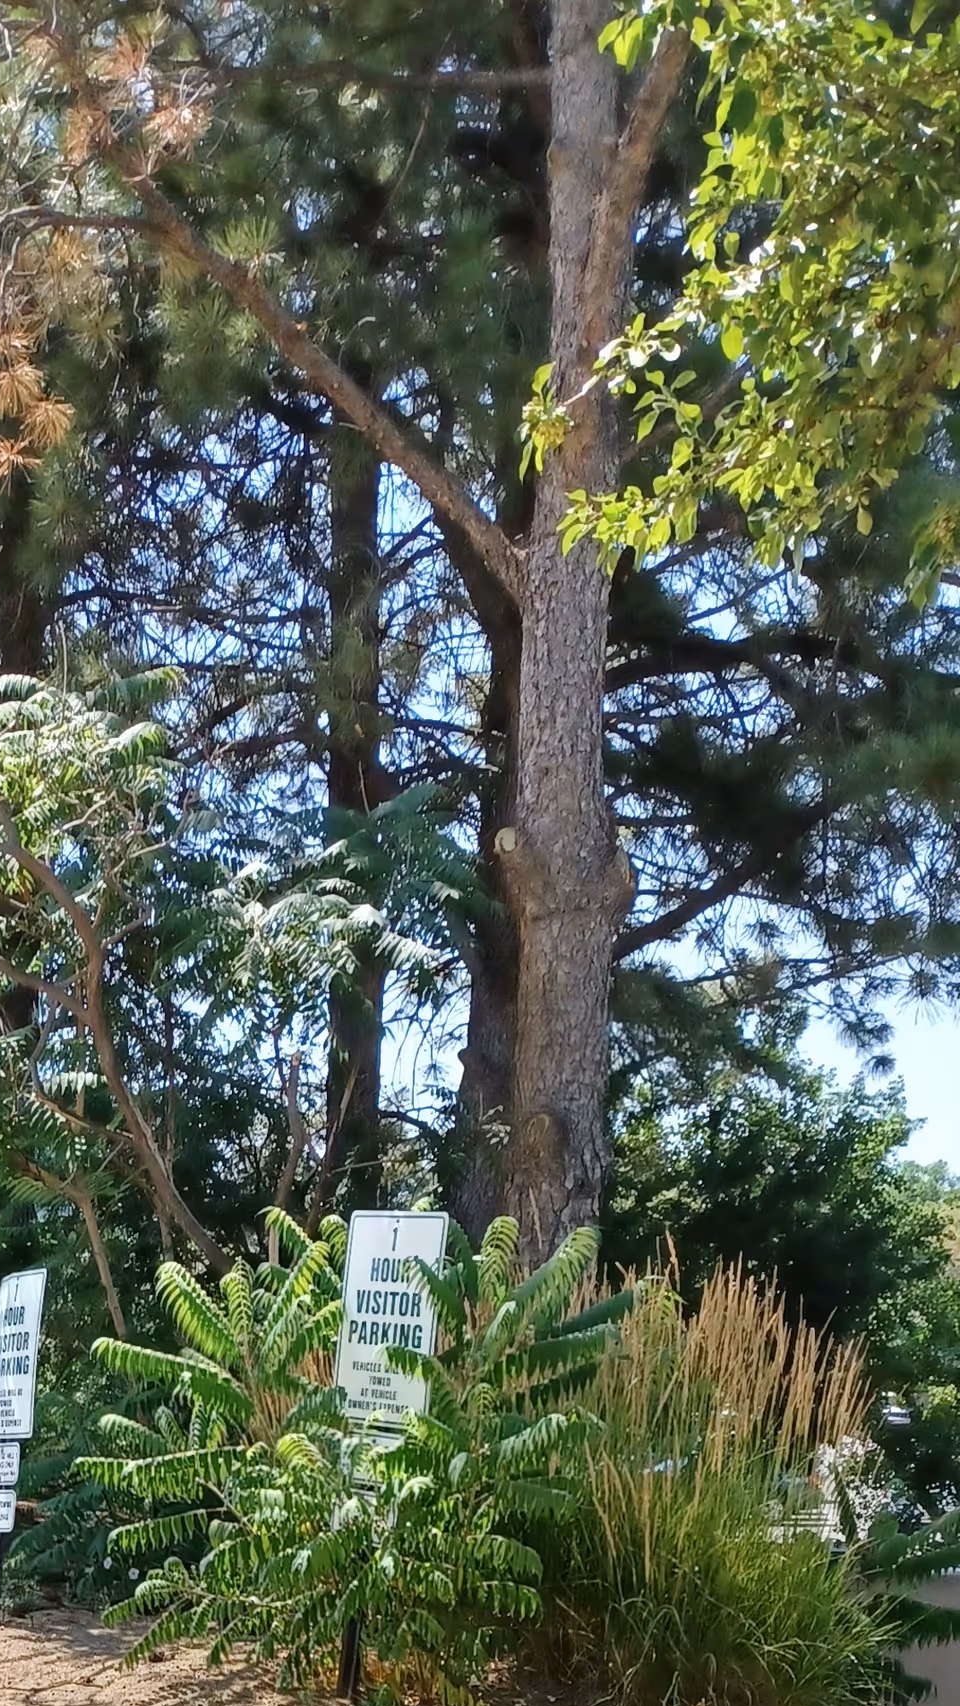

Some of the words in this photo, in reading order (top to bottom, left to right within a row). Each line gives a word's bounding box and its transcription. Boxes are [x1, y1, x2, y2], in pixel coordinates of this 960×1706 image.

[392, 1227, 398, 1251] 1
[357, 1290, 422, 1317] VISITOR
[3, 1305, 25, 1327] HOUR
[348, 1320, 423, 1349] PARKING
[369, 1376, 391, 1387] TOWED
[348, 1399, 377, 1411] OWNER'S
[360, 1388, 369, 1397] AT
[371, 1389, 397, 1400] VEHICLE
